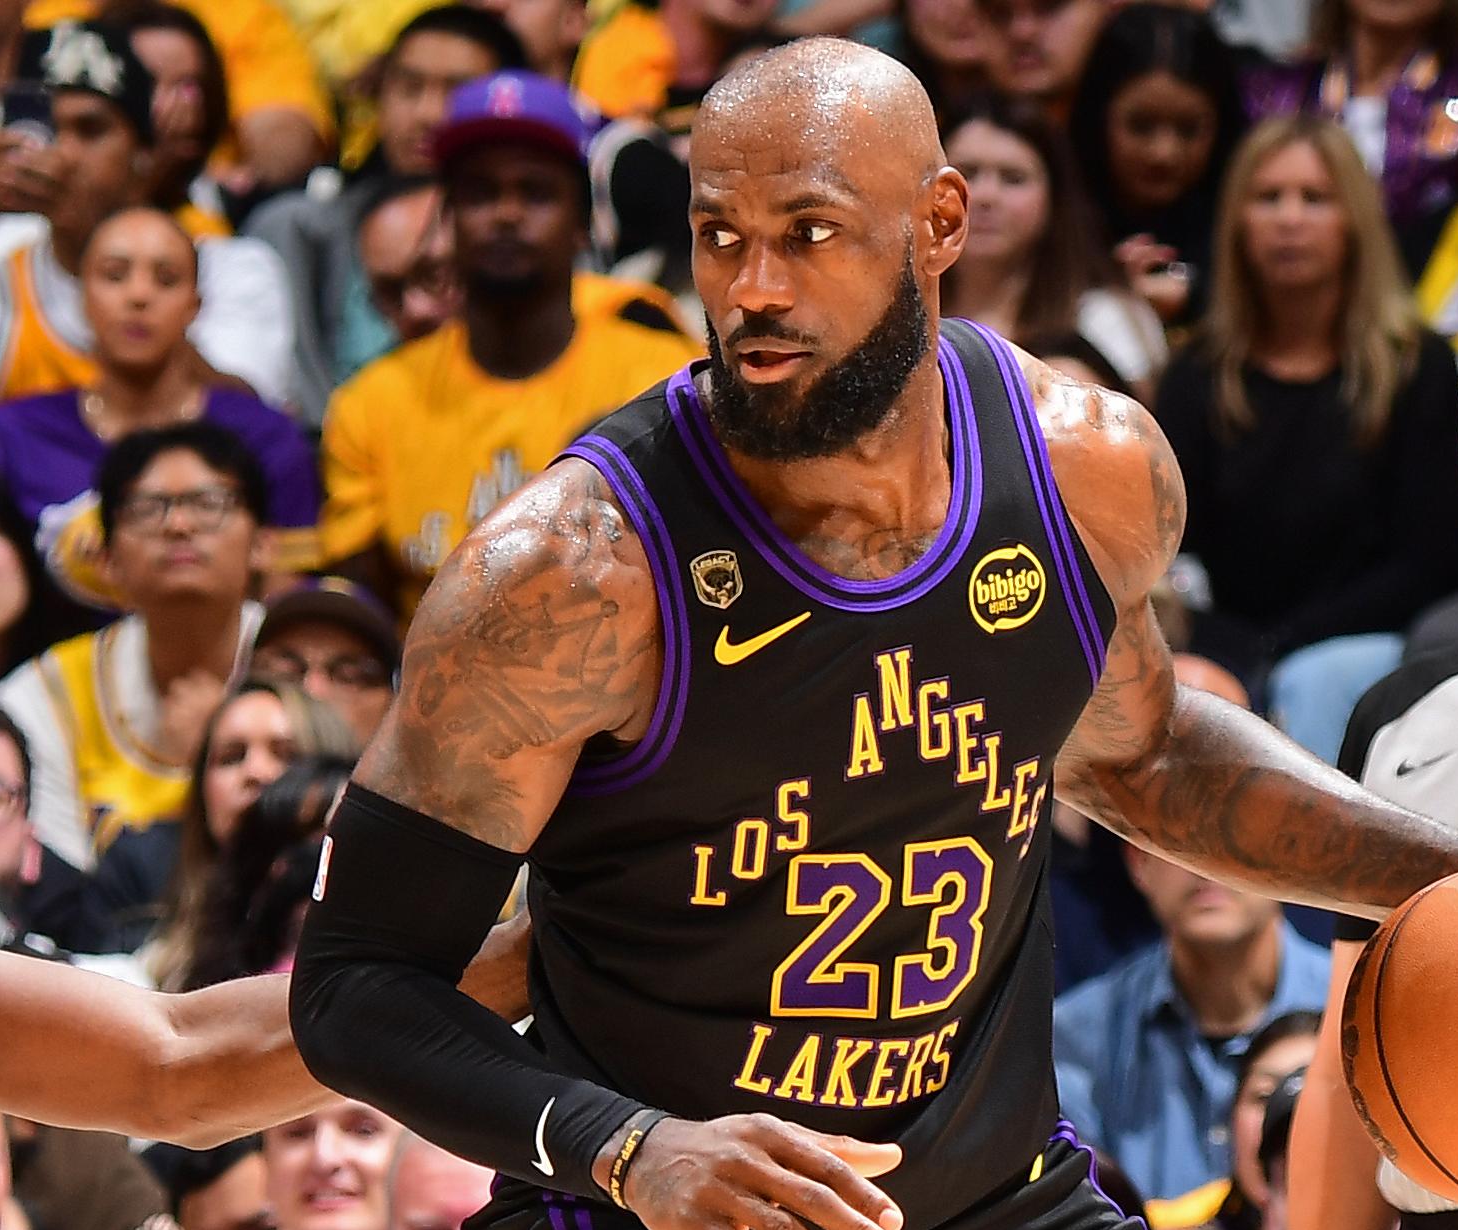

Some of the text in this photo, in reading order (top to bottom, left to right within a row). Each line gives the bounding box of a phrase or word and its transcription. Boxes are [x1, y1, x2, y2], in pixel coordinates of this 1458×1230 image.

[975, 567, 1040, 604] bibigo
[690, 777, 811, 906] LOS
[770, 836, 993, 1020] 23
[733, 1017, 962, 1110] LAKERS
